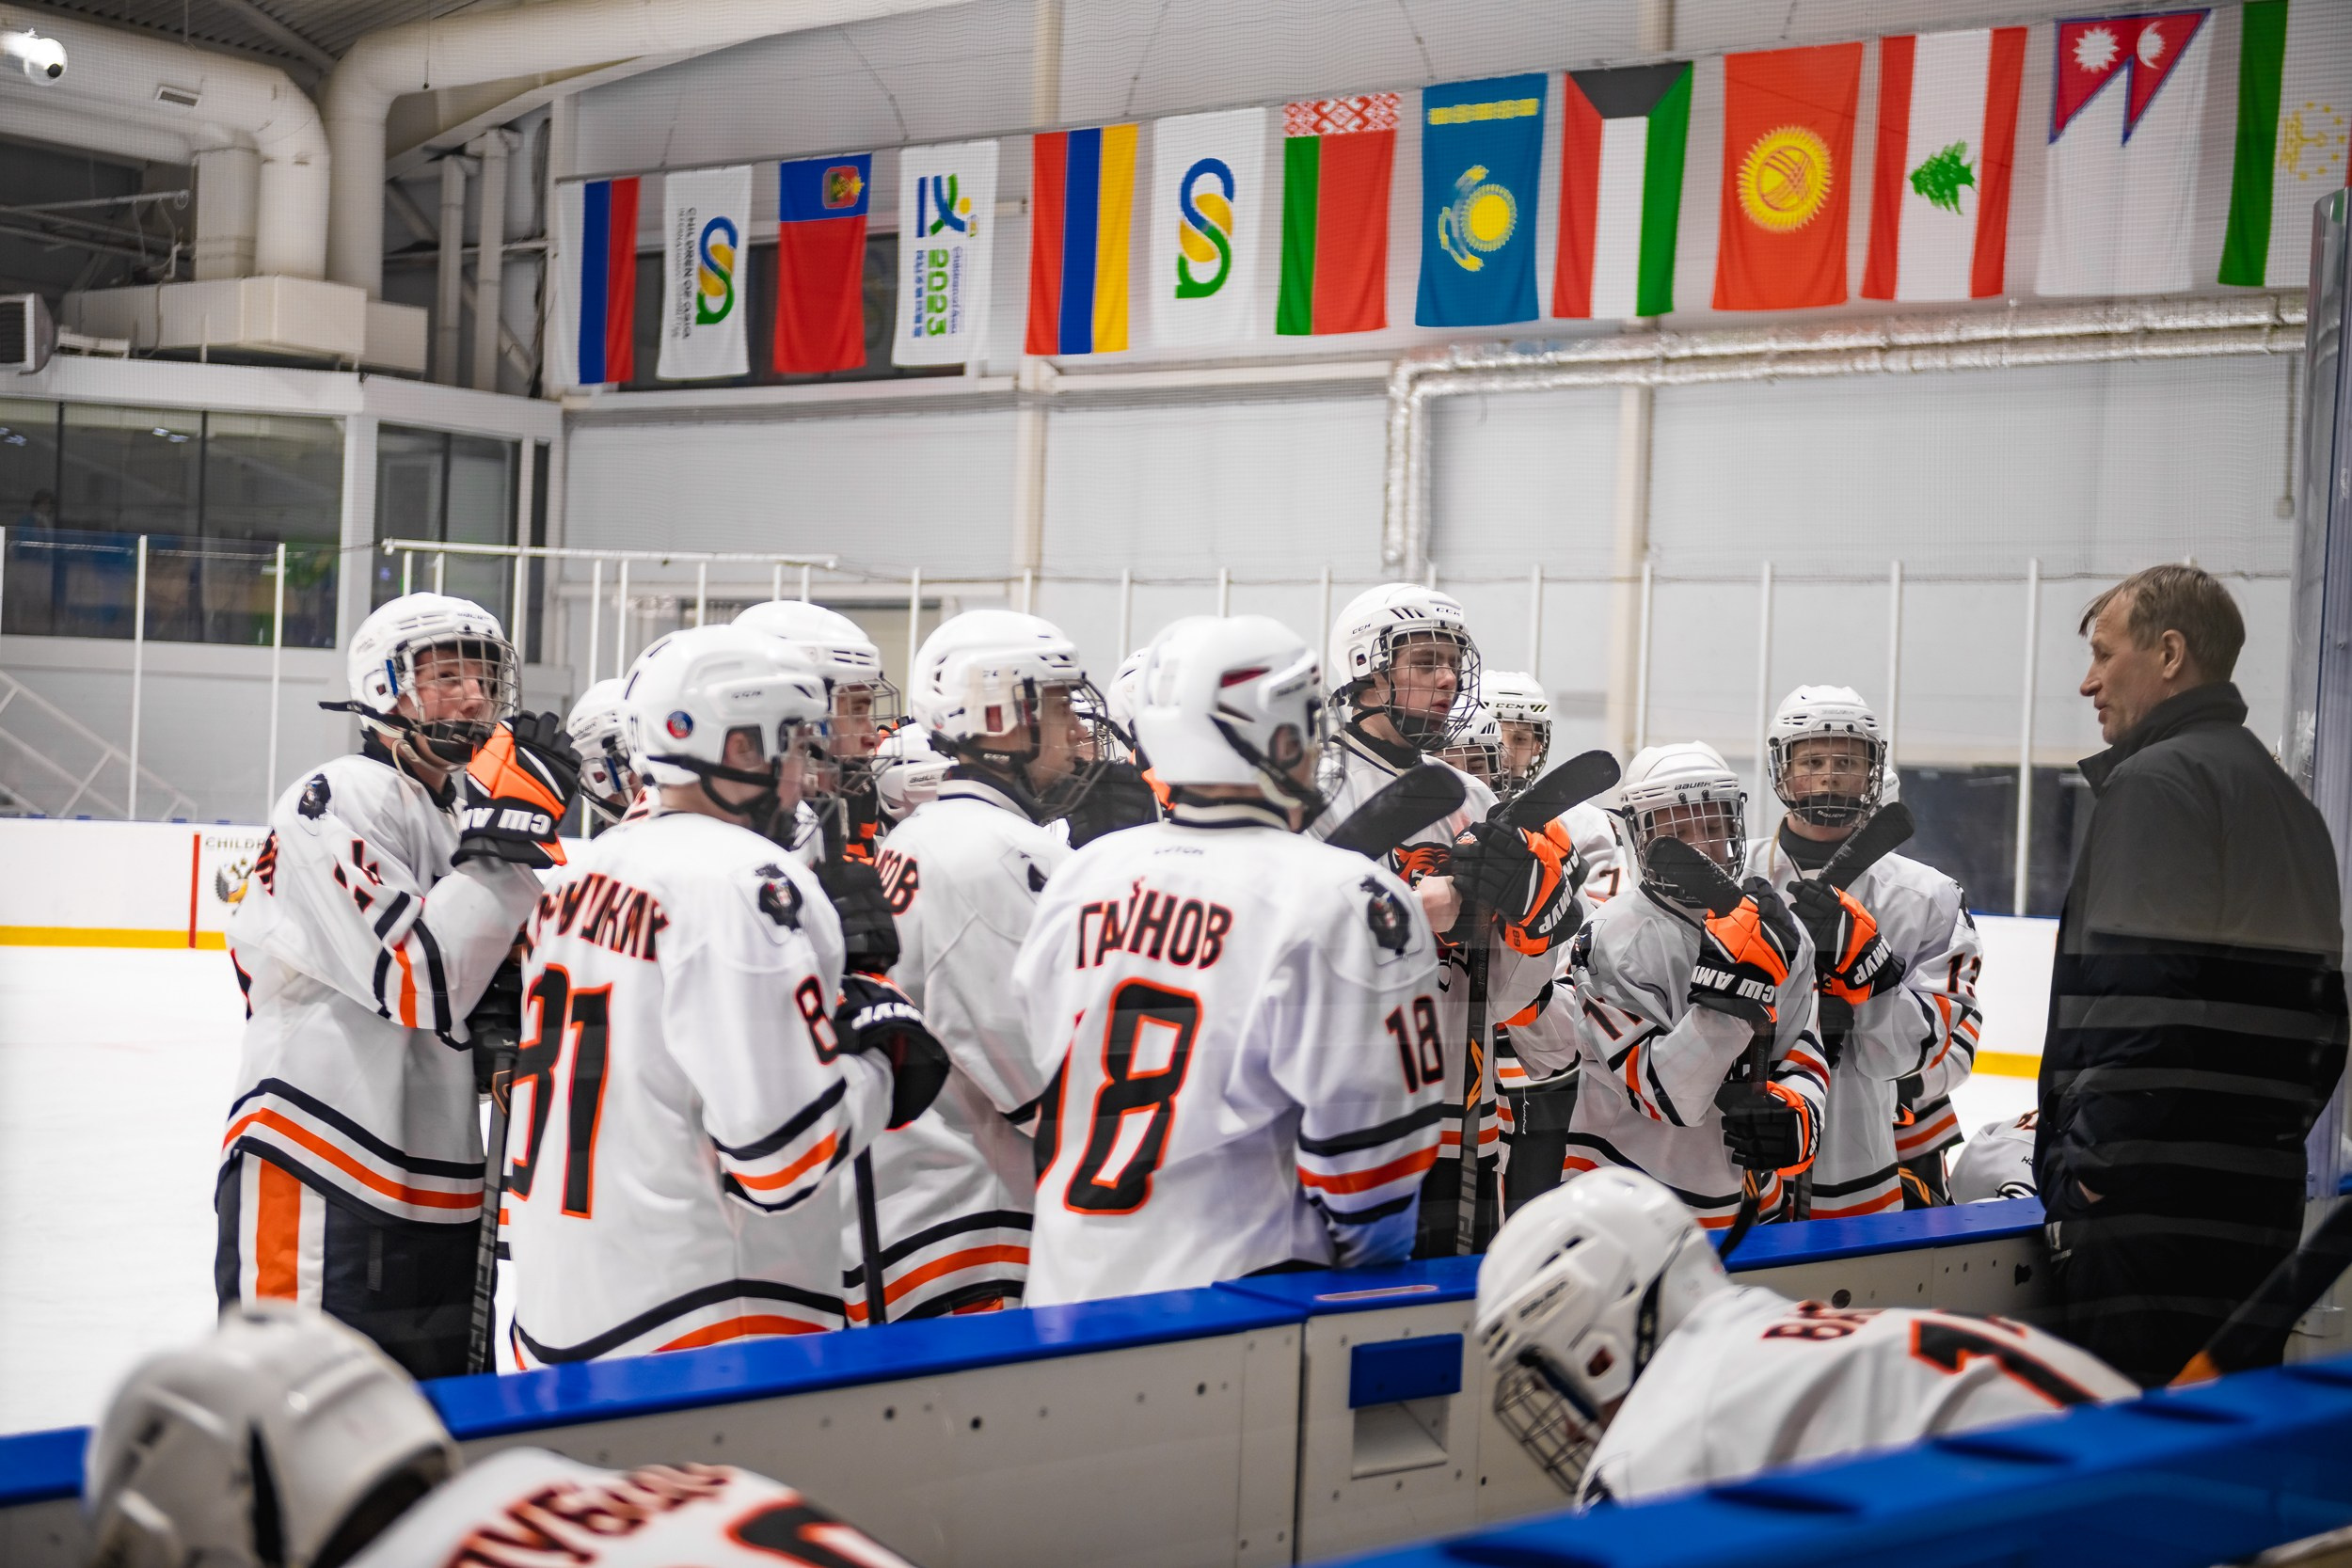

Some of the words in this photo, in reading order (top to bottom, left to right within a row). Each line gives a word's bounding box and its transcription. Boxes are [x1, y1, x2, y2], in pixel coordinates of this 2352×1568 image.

[926, 248, 950, 336] 2023
[1436, 607, 1461, 617] CCM
[1352, 624, 1372, 635] CCM
[1674, 781, 1712, 791] BAUER
[498, 808, 551, 835] СШ
[1736, 977, 1775, 1003] СШ
[1385, 994, 1445, 1094] 18
